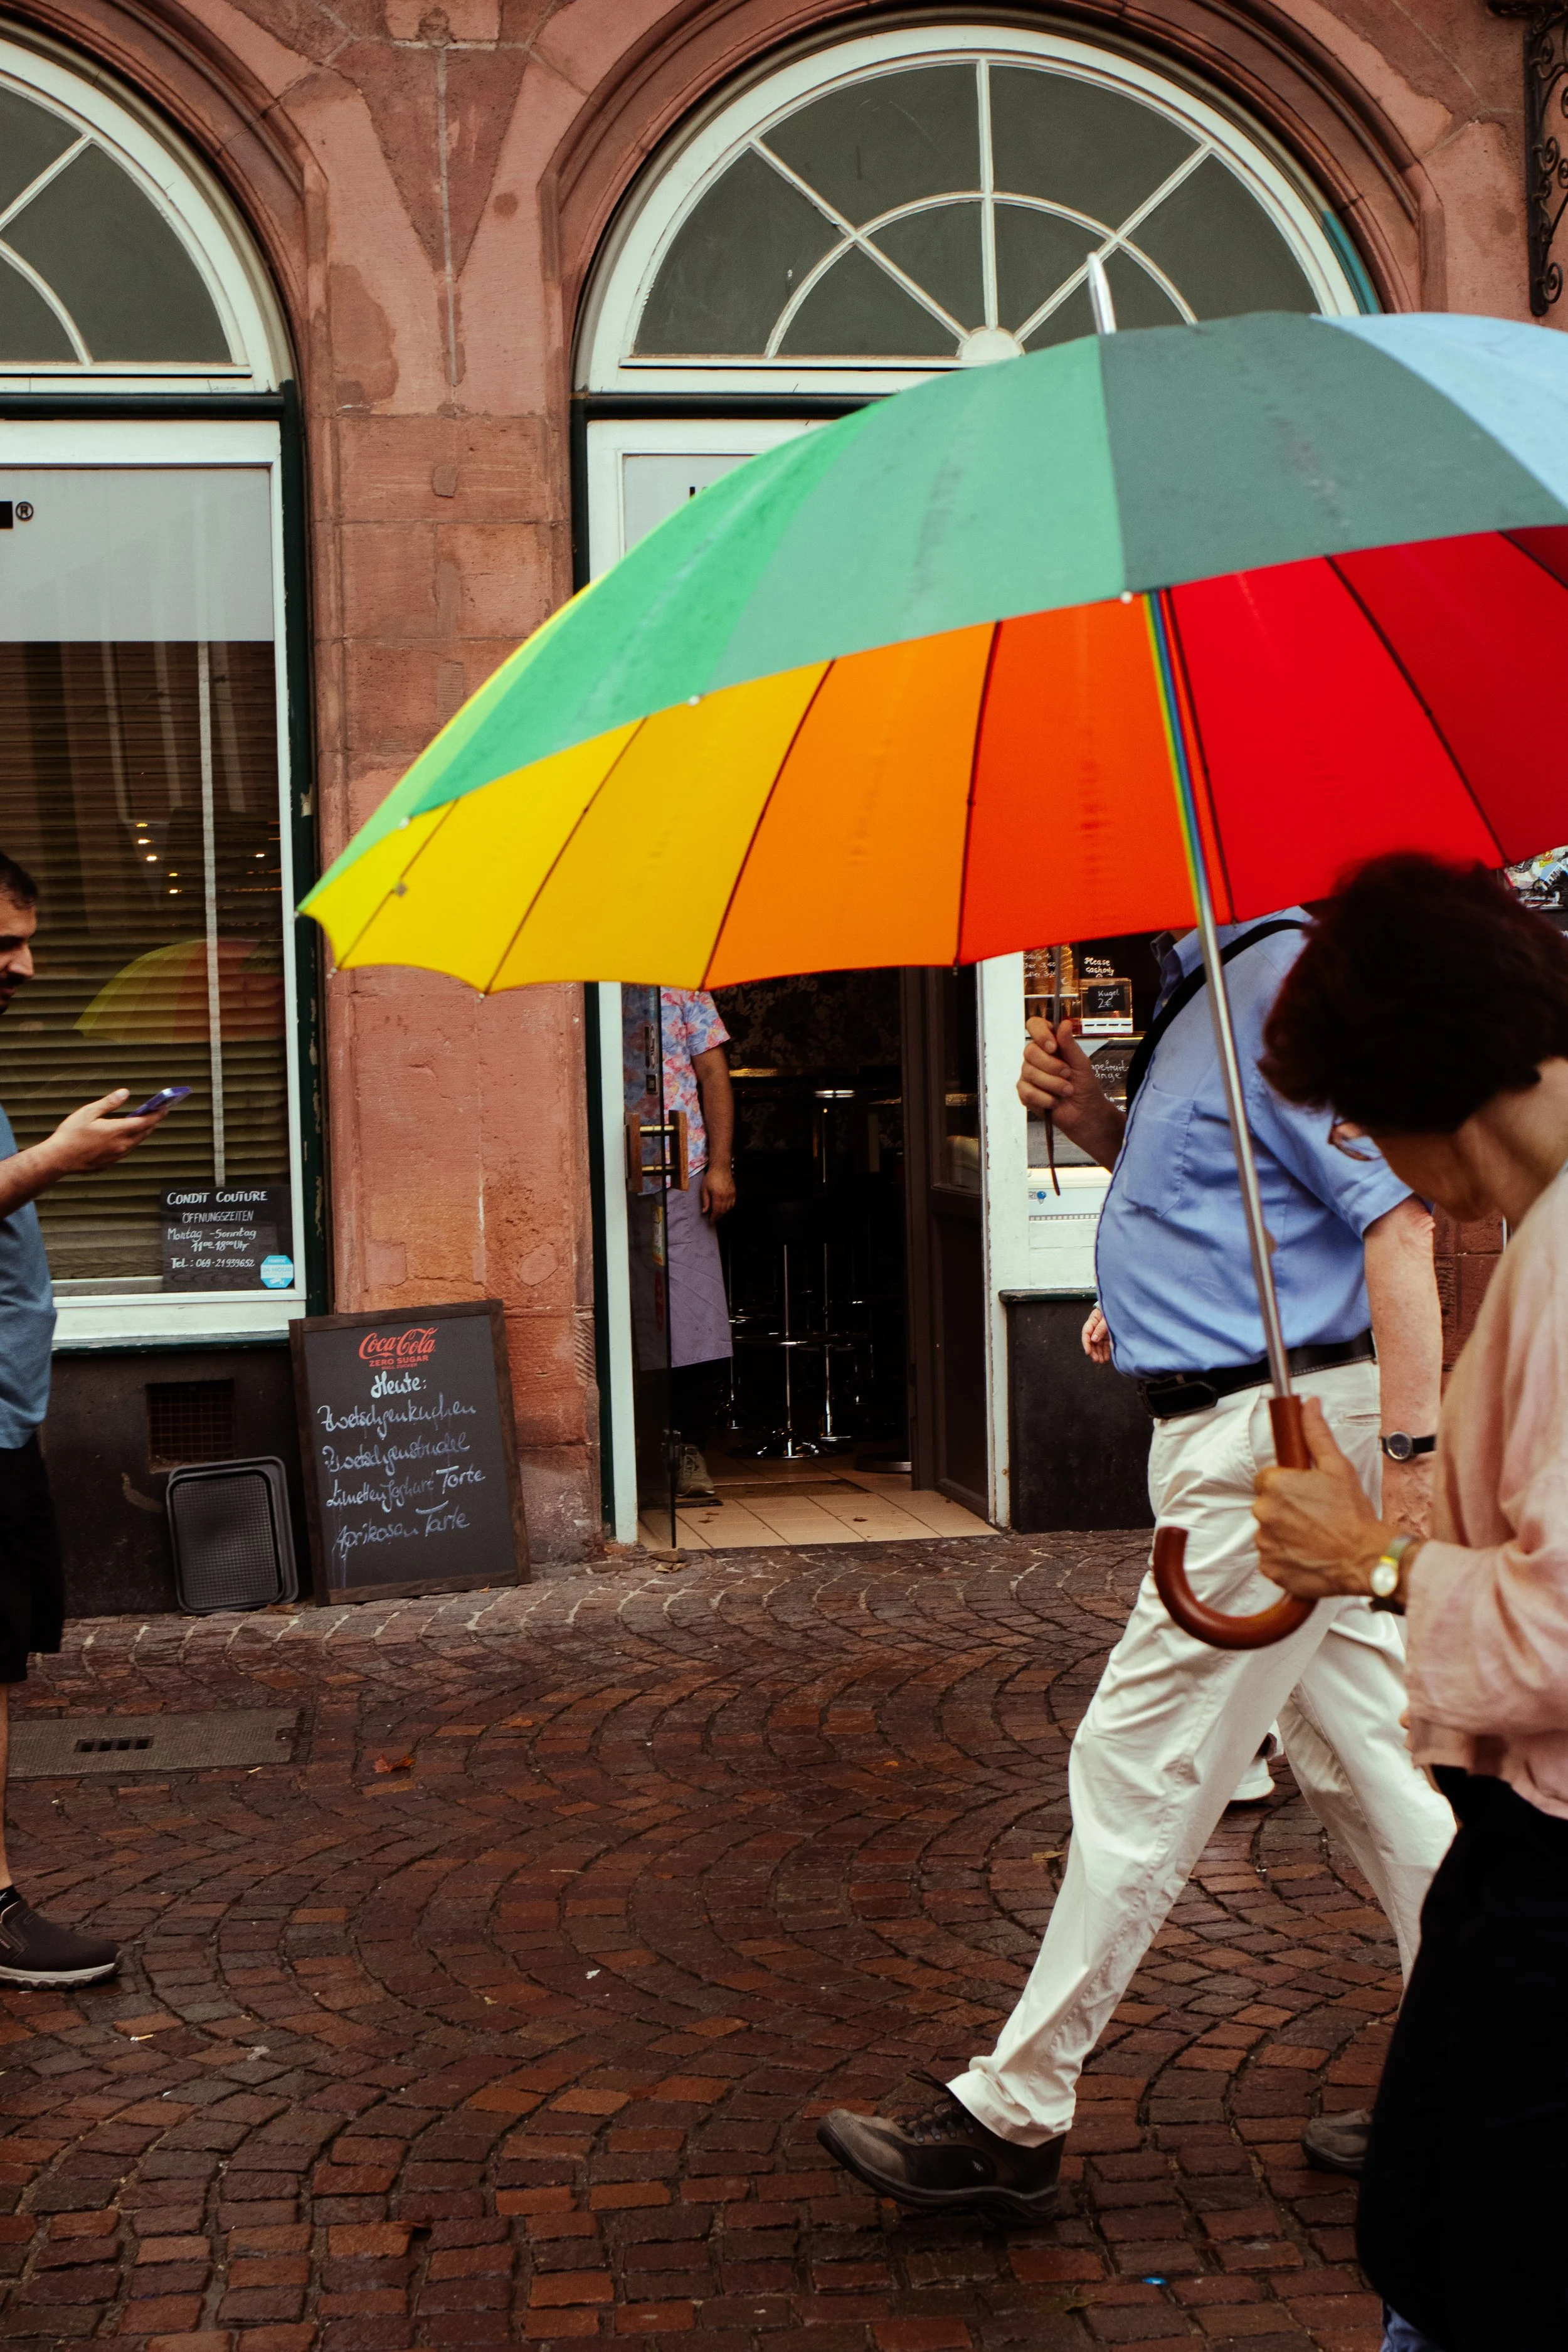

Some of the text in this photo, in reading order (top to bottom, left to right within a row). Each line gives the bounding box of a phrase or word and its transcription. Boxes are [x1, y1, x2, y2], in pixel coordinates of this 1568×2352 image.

[1084, 957, 1110, 966] Please
[1098, 988, 1120, 999] Kugel
[215, 1191, 268, 1203] COUTURE
[182, 1210, 255, 1224] ÖFFNUNGSZEITEN
[167, 1226, 203, 1242] Montag
[358, 1327, 439, 1360] Coca-Cola
[369, 1355, 429, 1367] ZERO SUGAR
[370, 1370, 426, 1399] Heute:
[317, 1392, 477, 1441] Zwetschgenkuchen
[436, 1465, 487, 1495] Torte
